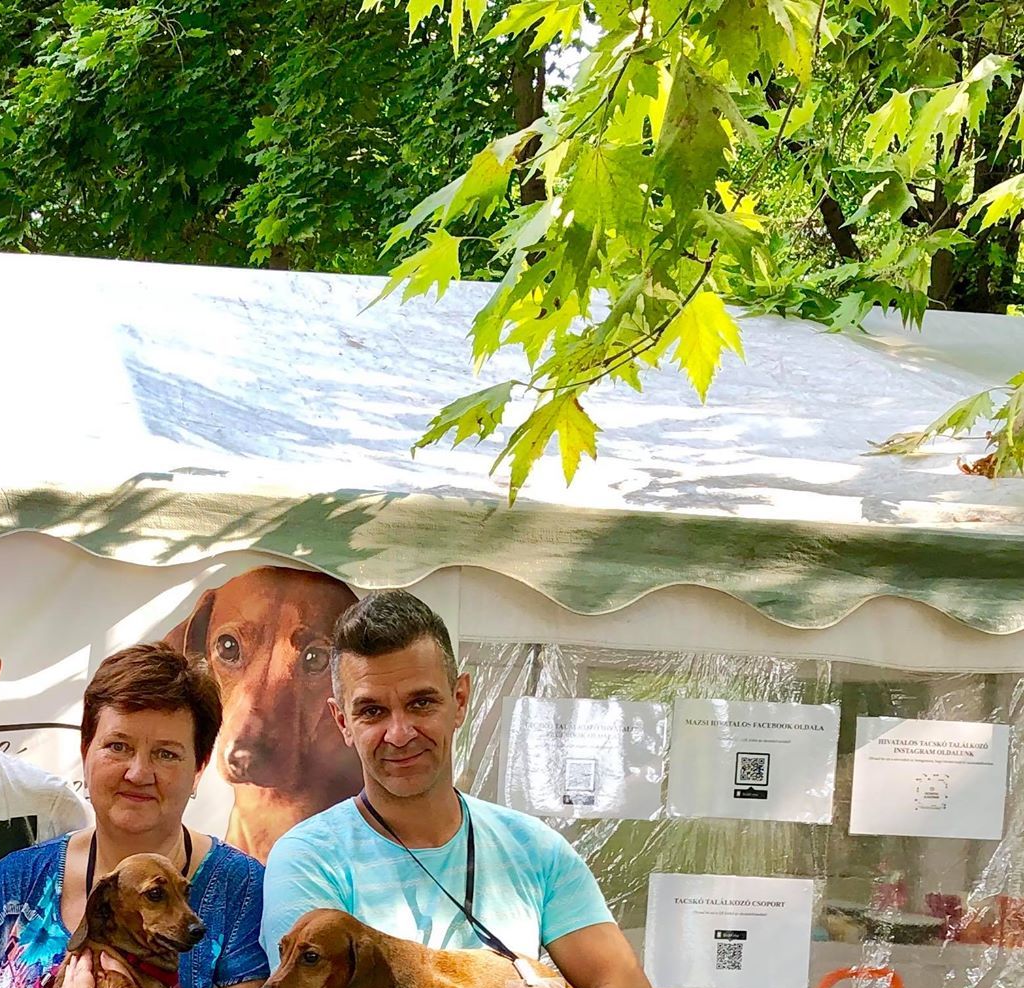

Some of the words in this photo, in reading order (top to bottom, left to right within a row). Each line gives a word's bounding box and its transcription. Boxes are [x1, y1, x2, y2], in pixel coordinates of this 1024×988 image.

[752, 721, 793, 730] FACEBOOK
[794, 723, 825, 732] OLDALA
[878, 738, 918, 747] HIVATALOS
[893, 747, 936, 755] INSTAGRAM
[936, 748, 974, 757] OLDALUNK
[674, 897, 704, 905] TACSKÓ
[706, 898, 751, 907] TALÁLKOZÓ
[752, 900, 786, 908] CSOPORT
